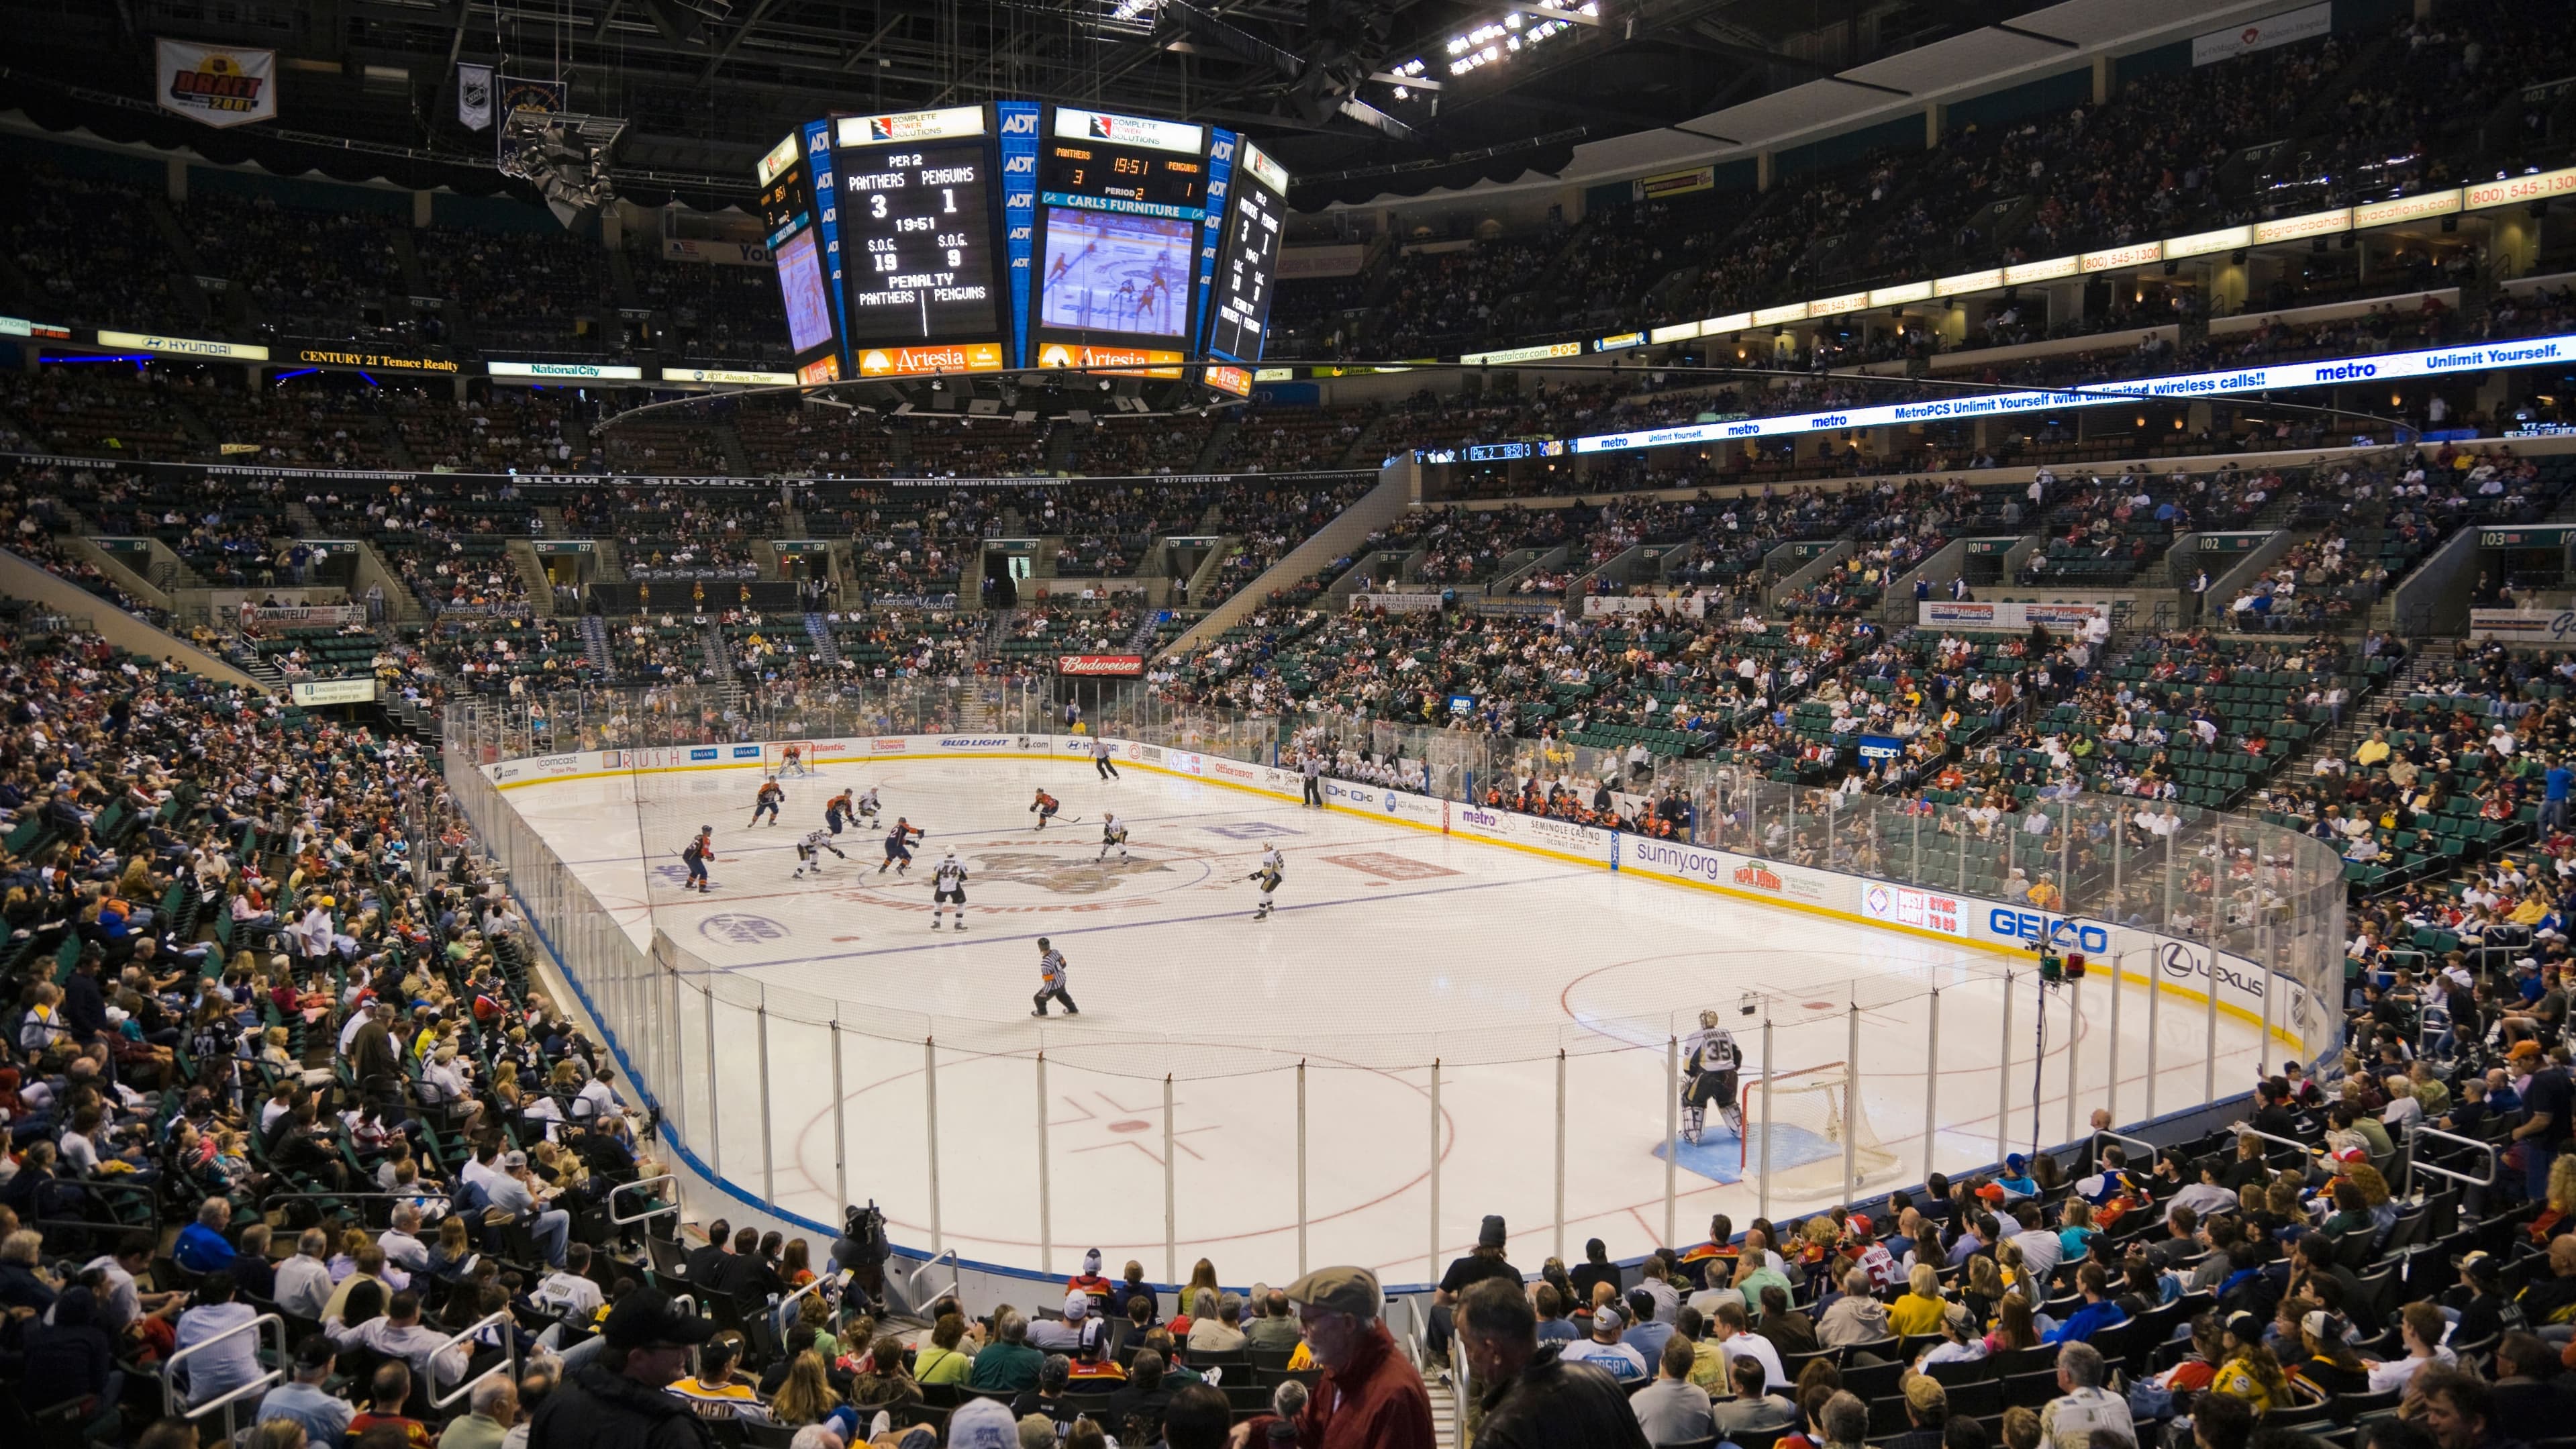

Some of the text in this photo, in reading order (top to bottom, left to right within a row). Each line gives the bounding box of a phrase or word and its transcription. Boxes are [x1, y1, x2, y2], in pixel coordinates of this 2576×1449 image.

[175, 70, 262, 99] DRAFT
[468, 89, 483, 103] NHL
[209, 97, 252, 112] 2001
[892, 113, 937, 123] COMPLETE
[1001, 114, 1037, 134] ADT
[1112, 118, 1158, 130] COMPLETE
[893, 122, 922, 130] POWER
[893, 128, 942, 138] SOLUTIONS
[1112, 126, 1142, 135] POWER
[1111, 134, 1160, 145] SOLUTIONS
[1211, 140, 1234, 161] ADT
[889, 154, 922, 168] PER 2
[1005, 156, 1034, 172] ADT
[1056, 148, 1197, 174] PANTHERS 19:51 PENGUINS
[848, 167, 974, 191] PANTHERS PENGUINS
[1073, 169, 1192, 197] 3 1
[1105, 187, 1144, 200] PERIOD 2
[1207, 180, 1227, 197] ADT
[871, 189, 957, 217] 3 1
[1007, 193, 1033, 207] ADT
[2468, 187, 2504, 205] (800)
[1067, 195, 1180, 216] CARLS FURNITURE
[895, 217, 935, 232] 19:51
[1204, 215, 1222, 230] ADT
[1009, 228, 1031, 240] ADT
[1242, 219, 1269, 255] 3 1
[868, 234, 968, 252] S.O.G. S.O.G.
[1201, 246, 1216, 259] ADT
[2083, 247, 2159, 270] (800) 545-1300
[874, 249, 960, 271] 19 9
[1012, 258, 1030, 268] ADT
[889, 273, 954, 289] PENALTY
[1200, 275, 1211, 285] ADT
[1232, 273, 1242, 291] 19
[859, 286, 986, 305] PANTHERS PENGUINS
[1810, 297, 1867, 316] (800) 545-1300
[169, 340, 231, 355] HYUNDAI
[300, 350, 459, 373] CENTURY 21 Tenace Realty
[897, 348, 964, 372] Artesia
[1077, 348, 1145, 366] Artesia
[2426, 344, 2561, 368] Unlimit Yourself.
[725, 374, 750, 383] Always
[808, 360, 827, 385] Artesia
[1217, 366, 1240, 385] Artesia
[1895, 403, 1950, 419] MetroPCS
[1954, 399, 1996, 413] Unlimit
[2000, 394, 2050, 408] Yourself
[2154, 379, 2215, 395] wireless
[2221, 372, 2265, 389] calls!!
[1812, 414, 1847, 428] metro
[1674, 430, 1703, 440] Yourself.
[1728, 423, 1760, 436] metro
[1601, 437, 1628, 448] metro
[1463, 444, 1530, 460] 1 Per. 2 19:52 3
[55, 459, 116, 469] STOCK LAW
[643, 478, 755, 487] SILVER,
[1269, 472, 1375, 481] www.stockattorneys.com
[1169, 540, 1181, 548] 129
[2201, 538, 2219, 550] 102
[2482, 532, 2505, 545] 103
[134, 542, 146, 551] 124
[344, 544, 356, 552] 125
[1644, 549, 1653, 558] 133
[1795, 546, 1807, 556] 134
[1968, 542, 1981, 553] 101
[1380, 554, 1389, 562] 131
[1527, 552, 1535, 560] 132
[439, 603, 531, 617] American Yacht
[873, 597, 954, 609] American Yacht
[256, 608, 310, 621] CANNATELLI
[1938, 606, 1992, 619] BankAtlantic
[1060, 656, 1140, 673] Budweiser
[1452, 699, 1471, 707] BUD
[940, 738, 1009, 747] BUD LIGHT
[1030, 741, 1048, 749] .com
[624, 750, 680, 768] RUSH
[693, 750, 715, 759] DASANI
[736, 748, 758, 757] DASANI
[1860, 746, 1901, 758] GEICO
[538, 756, 577, 768] comcast
[503, 766, 518, 777] .com
[551, 766, 578, 775] Triple Play
[1216, 763, 1254, 779] Office DEPOT
[1337, 788, 1346, 797] HD
[1364, 794, 1373, 803] HD
[1408, 802, 1422, 815] Always
[1463, 809, 1516, 832] metroPCS
[1530, 820, 1600, 841] SEMINOLE CASINO
[1638, 844, 1718, 880] sunny.org
[941, 865, 958, 879] 44
[1734, 867, 1754, 885] PAPA
[1707, 1039, 1731, 1060] 35
[546, 1282, 571, 1297] CROSBY
